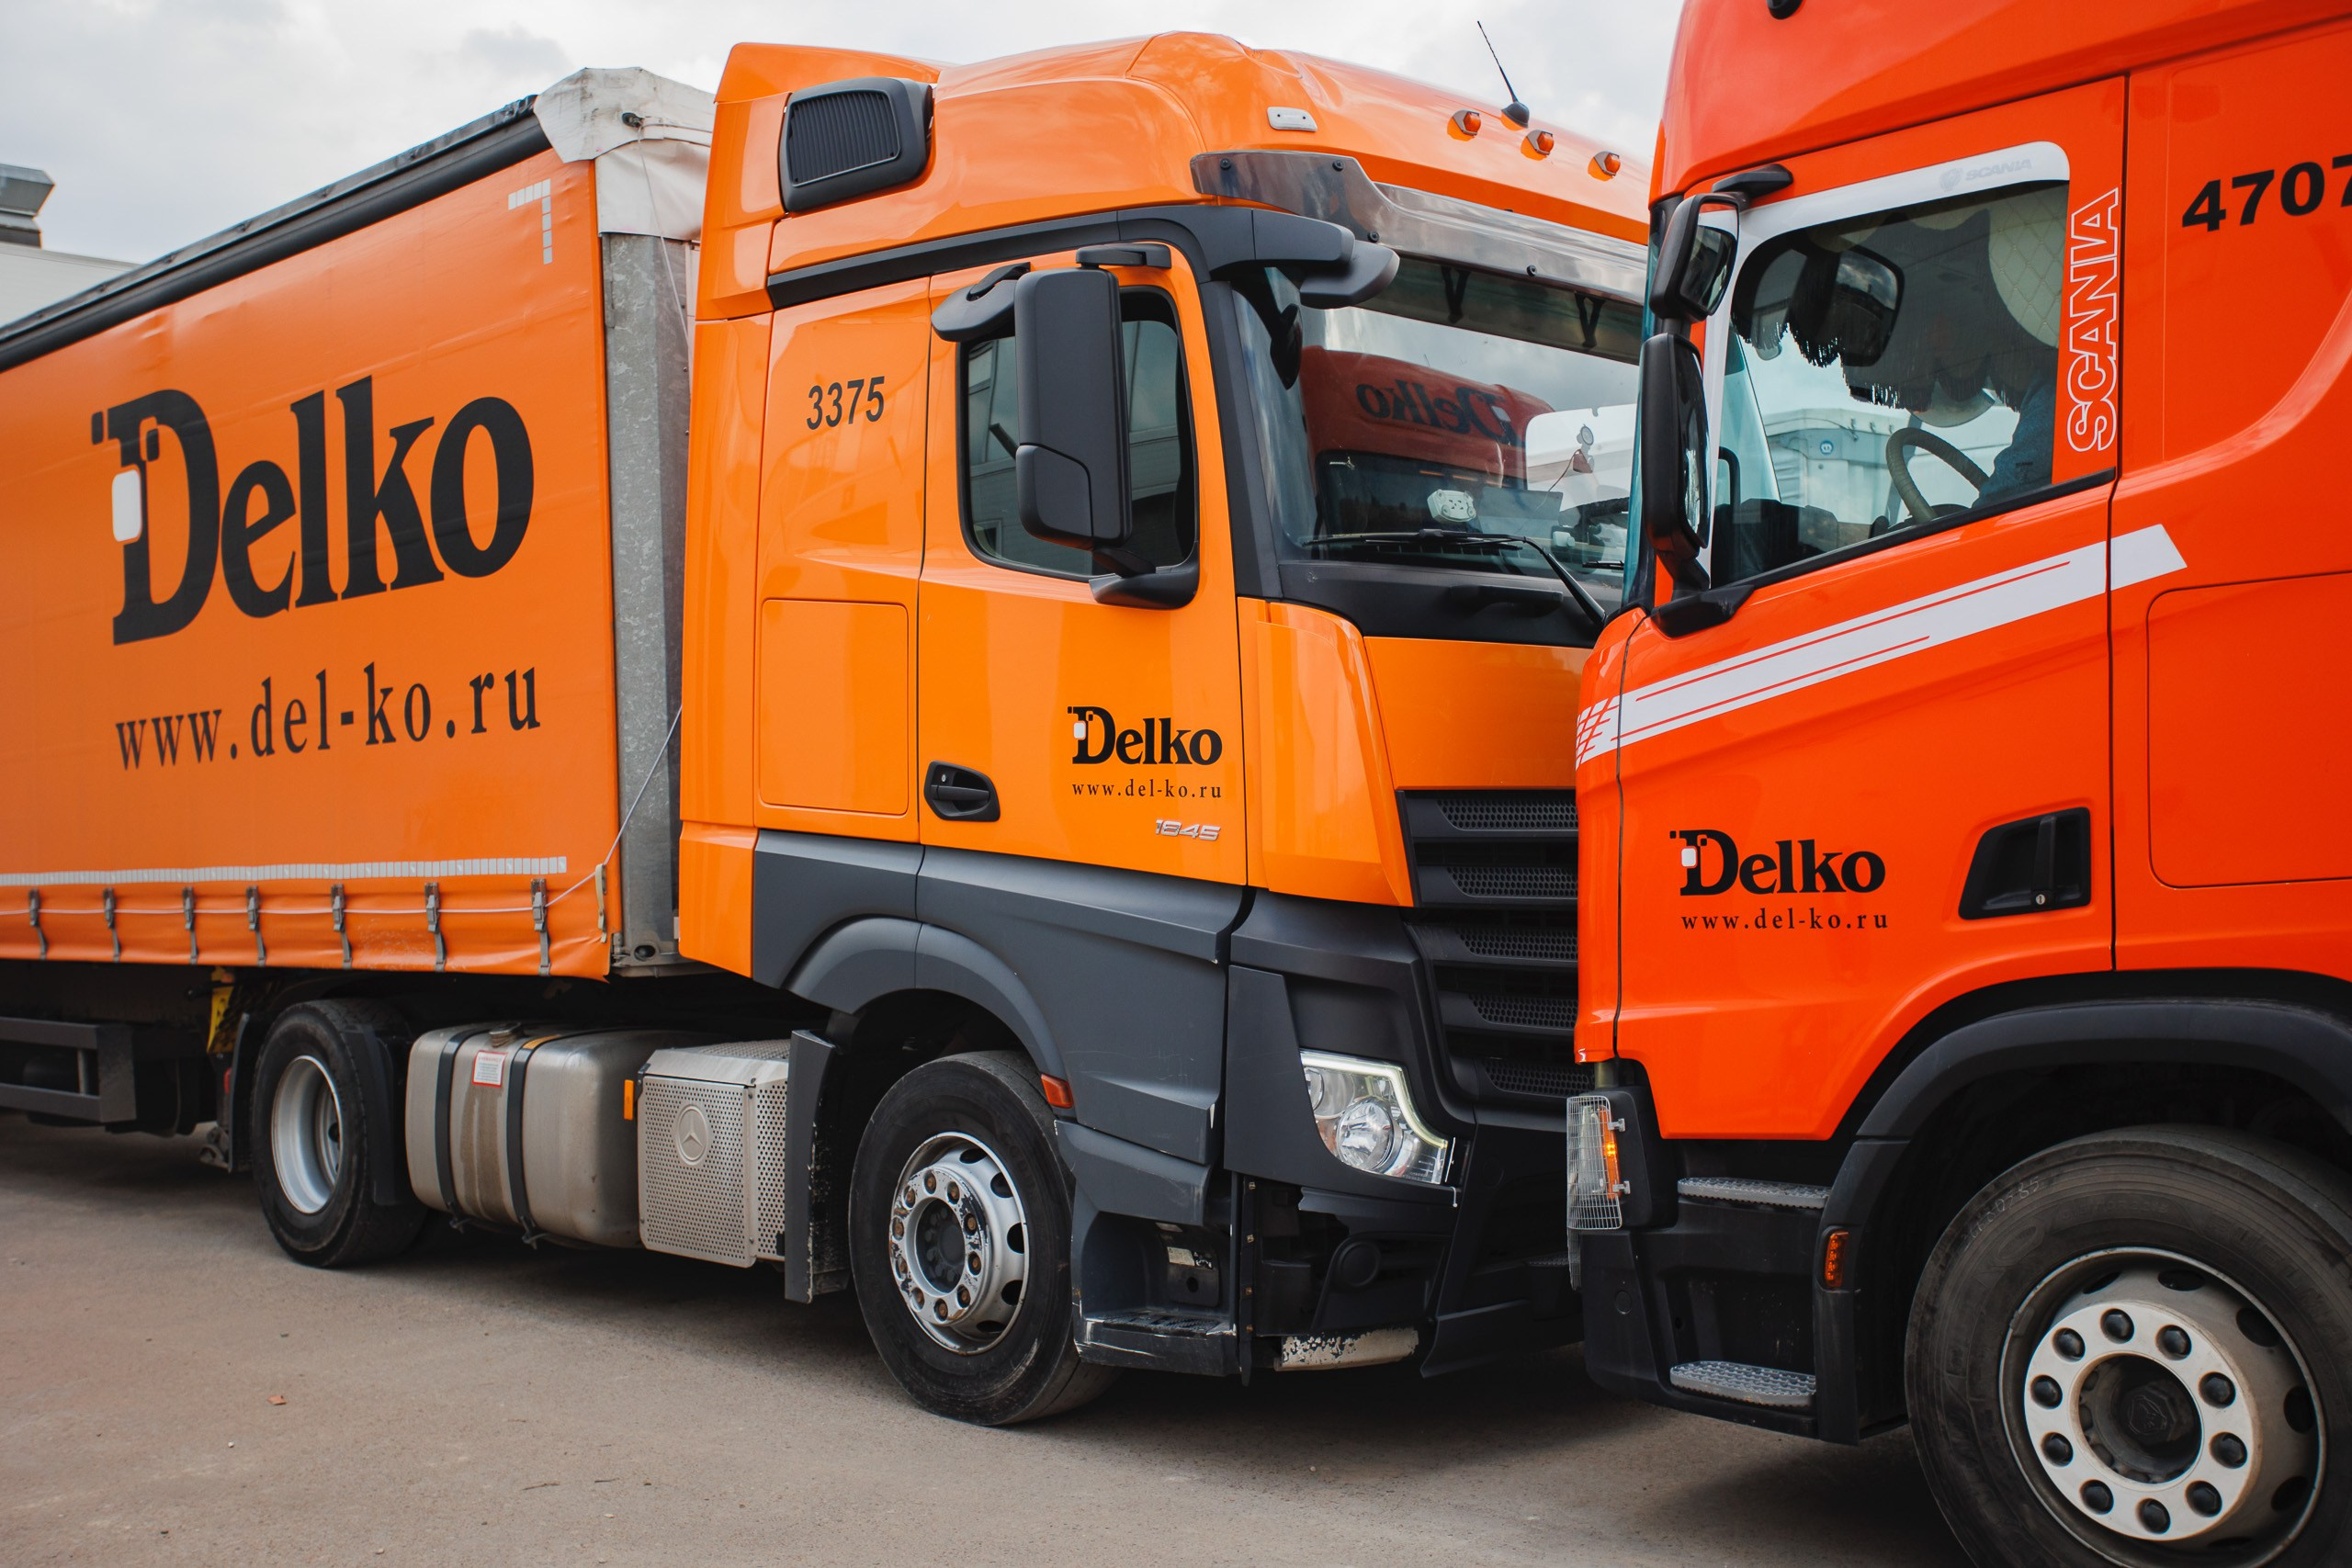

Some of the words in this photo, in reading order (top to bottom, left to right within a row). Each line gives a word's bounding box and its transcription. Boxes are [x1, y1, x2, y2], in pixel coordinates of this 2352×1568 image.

[1965, 159, 2032, 180] SCANIA
[2066, 186, 2120, 453] SCANIA
[806, 376, 886, 431] 3375
[91, 375, 534, 646] Delko
[116, 662, 541, 771] www.del-ko.ru
[1067, 705, 1223, 765] Delko
[1072, 778, 1222, 798] www.del-ko.ru
[1155, 818, 1221, 841] 1845
[1669, 829, 1886, 897] Delko
[1681, 907, 1888, 930] www.del-ko.ru
